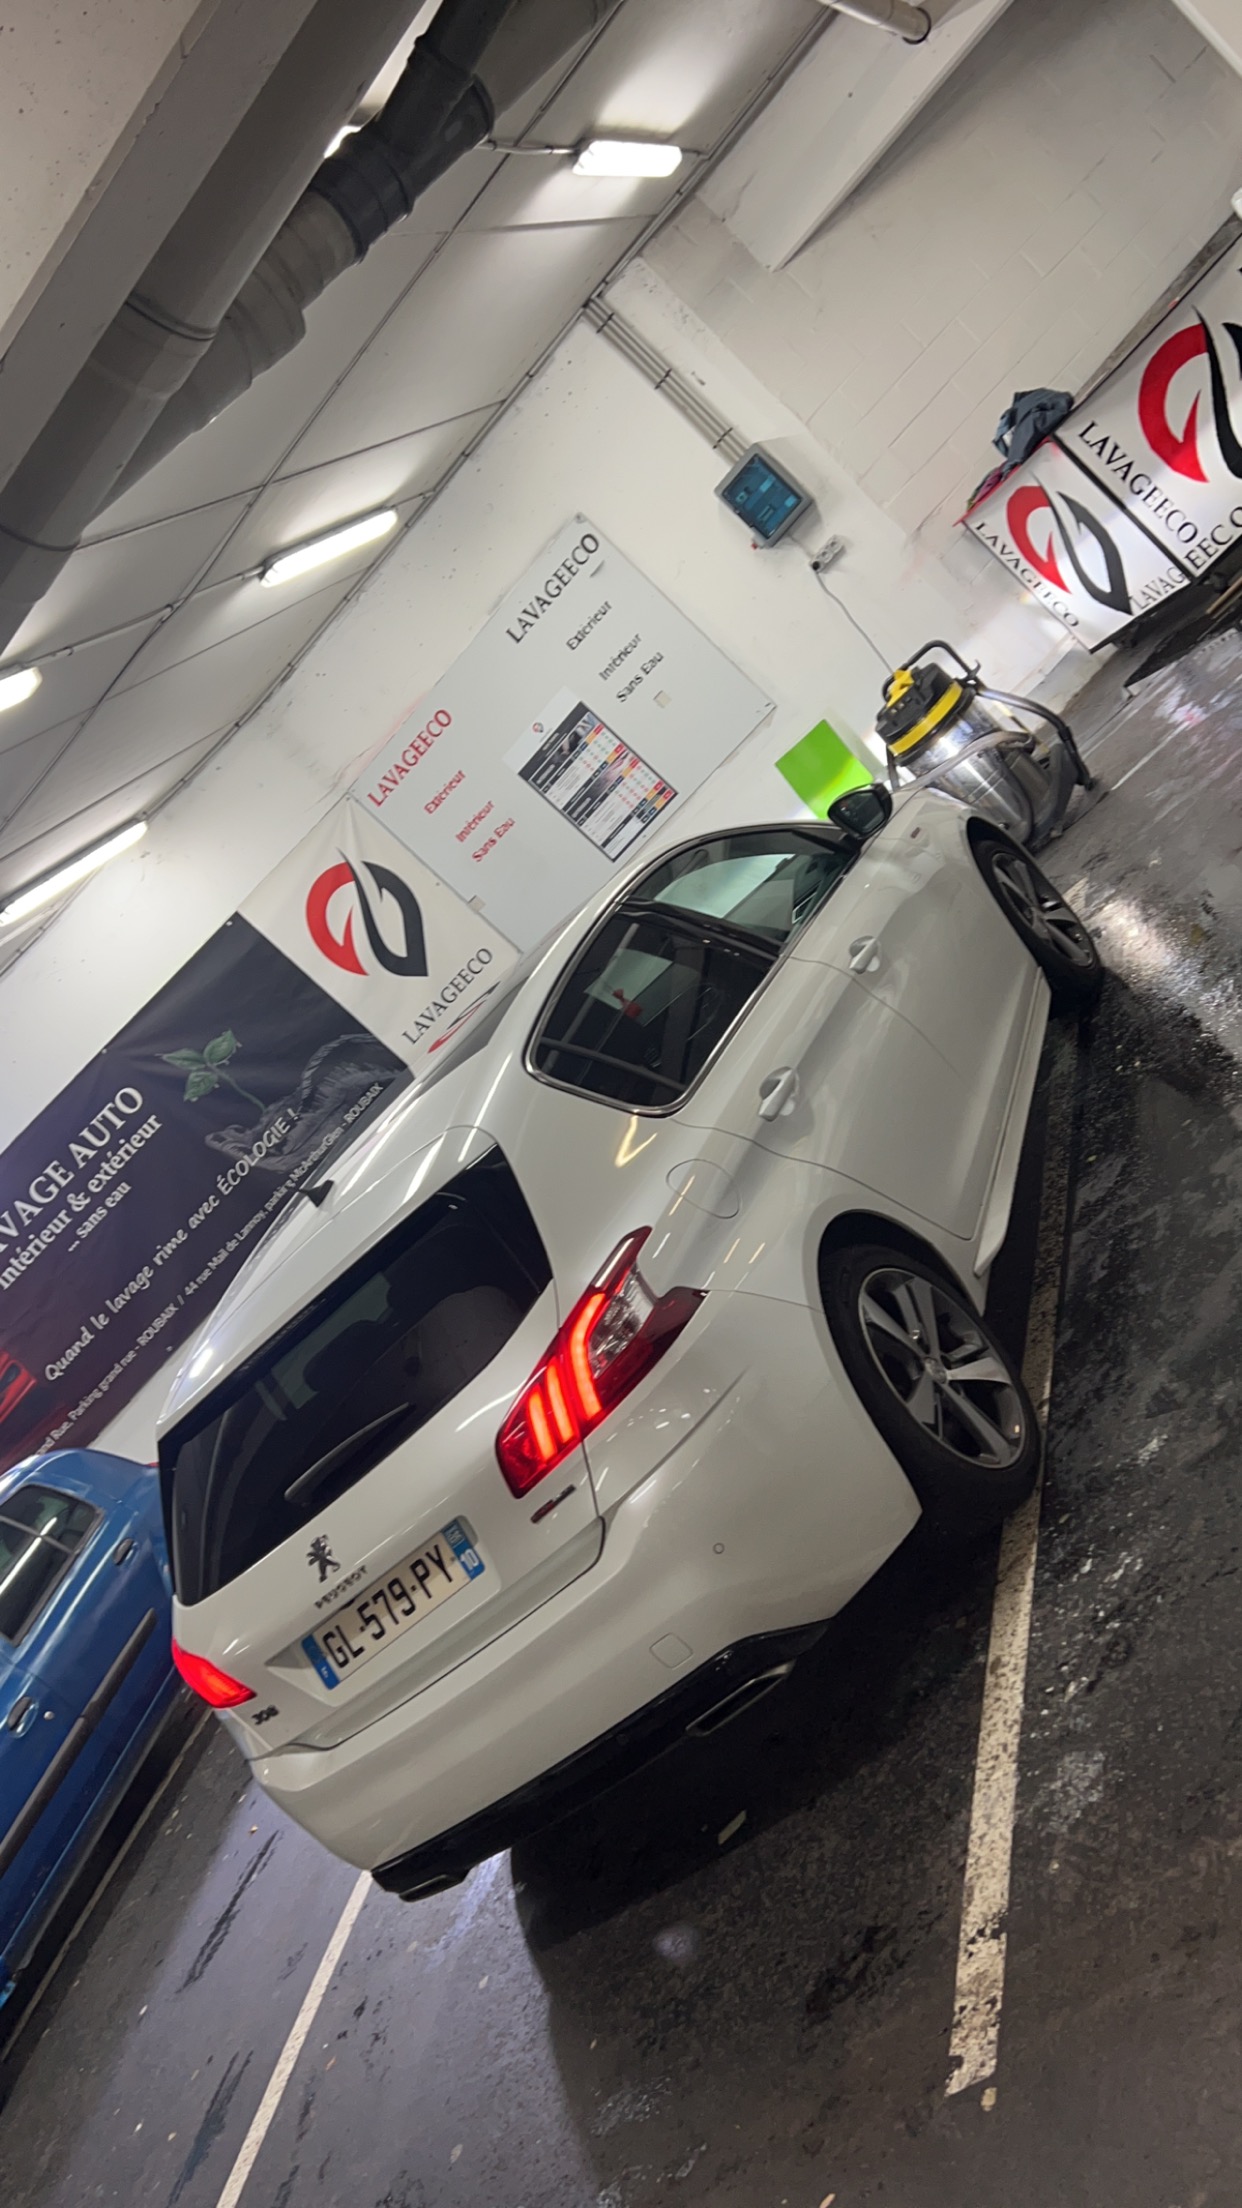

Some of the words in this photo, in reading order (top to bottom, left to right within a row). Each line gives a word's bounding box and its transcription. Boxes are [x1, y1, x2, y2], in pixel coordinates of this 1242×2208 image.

[1078, 421, 1198, 544] LAVAGEECO
[506, 533, 600, 644] LAVAGEECO
[976, 522, 1079, 627] LAVAGEECO
[566, 601, 613, 651] Extérieur
[598, 633, 642, 681] Intérieur
[616, 673, 644, 703] Sans
[640, 651, 664, 675] Eau
[367, 709, 452, 807] LAVAGEECO
[423, 769, 466, 814] Extérieur
[455, 800, 495, 843] Intérieur
[472, 837, 497, 863] Sans
[493, 817, 516, 838] Eau
[402, 948, 493, 1045] LAVAGEECO
[0, 1160, 75, 1253] VAGE
[68, 1087, 143, 1169] AUTO
[66, 1192, 91, 1212] &
[87, 1114, 163, 1193] extérieur
[76, 1206, 108, 1238] sans
[105, 1182, 132, 1208] eau
[45, 1326, 95, 1381] Quand
[90, 1312, 110, 1330] le
[105, 1265, 154, 1313] lavage
[153, 1228, 188, 1266] rime
[188, 1194, 220, 1229] avec
[216, 1116, 291, 1195] ÉCOLOGIE
[67, 1388, 103, 1420] Parking
[98, 1363, 123, 1392] grand
[120, 1349, 138, 1367] rue
[136, 1302, 179, 1347] ROUBAIX
[184, 1281, 199, 1296] 44
[196, 1268, 213, 1285] rue
[207, 1247, 230, 1269] Mail
[225, 1237, 239, 1252] de
[343, 1082, 384, 1124] ROUBAIX
[314, 1564, 368, 1609] PEUGEOT
[322, 1544, 453, 1668] GL-579-PY
[460, 1548, 480, 1571] 10
